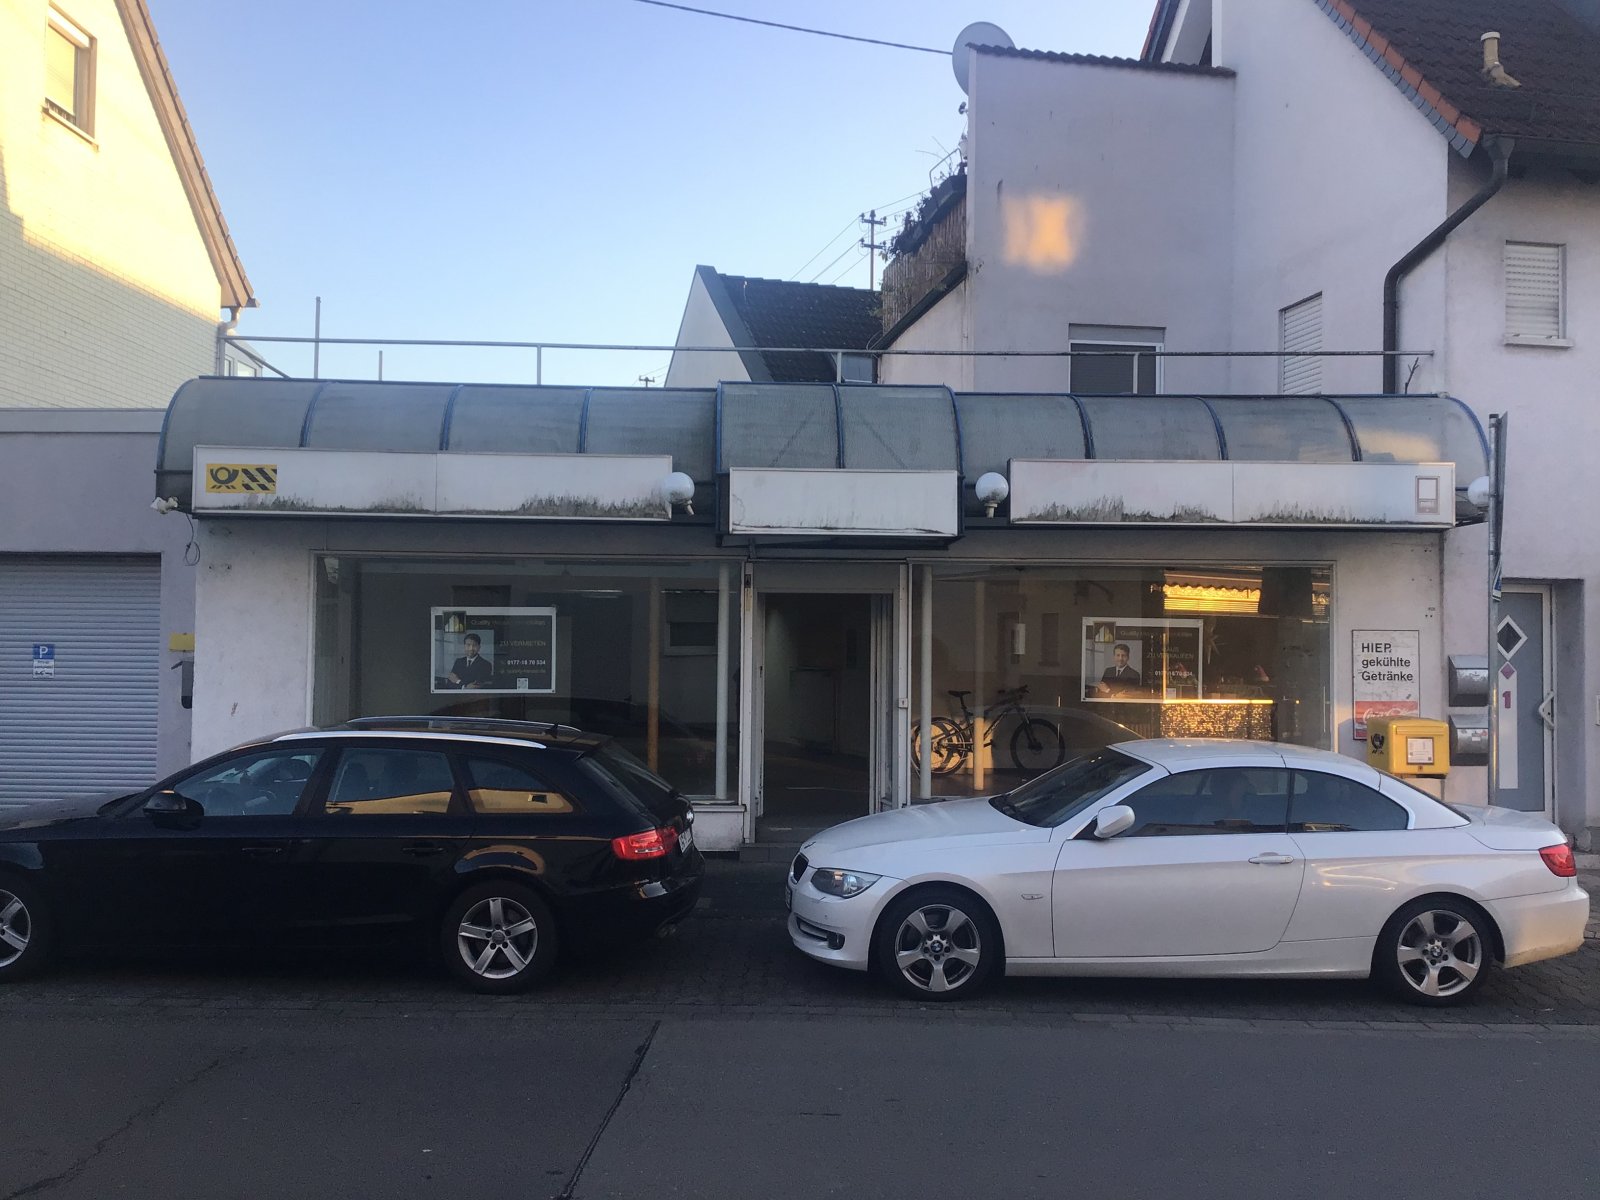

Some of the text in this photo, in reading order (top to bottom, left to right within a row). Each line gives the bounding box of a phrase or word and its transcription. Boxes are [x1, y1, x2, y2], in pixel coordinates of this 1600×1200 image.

[39, 645, 49, 659] P
[1361, 656, 1411, 669] gekühlte
[1361, 670, 1414, 681] Getränke
[1502, 690, 1512, 709] 1
